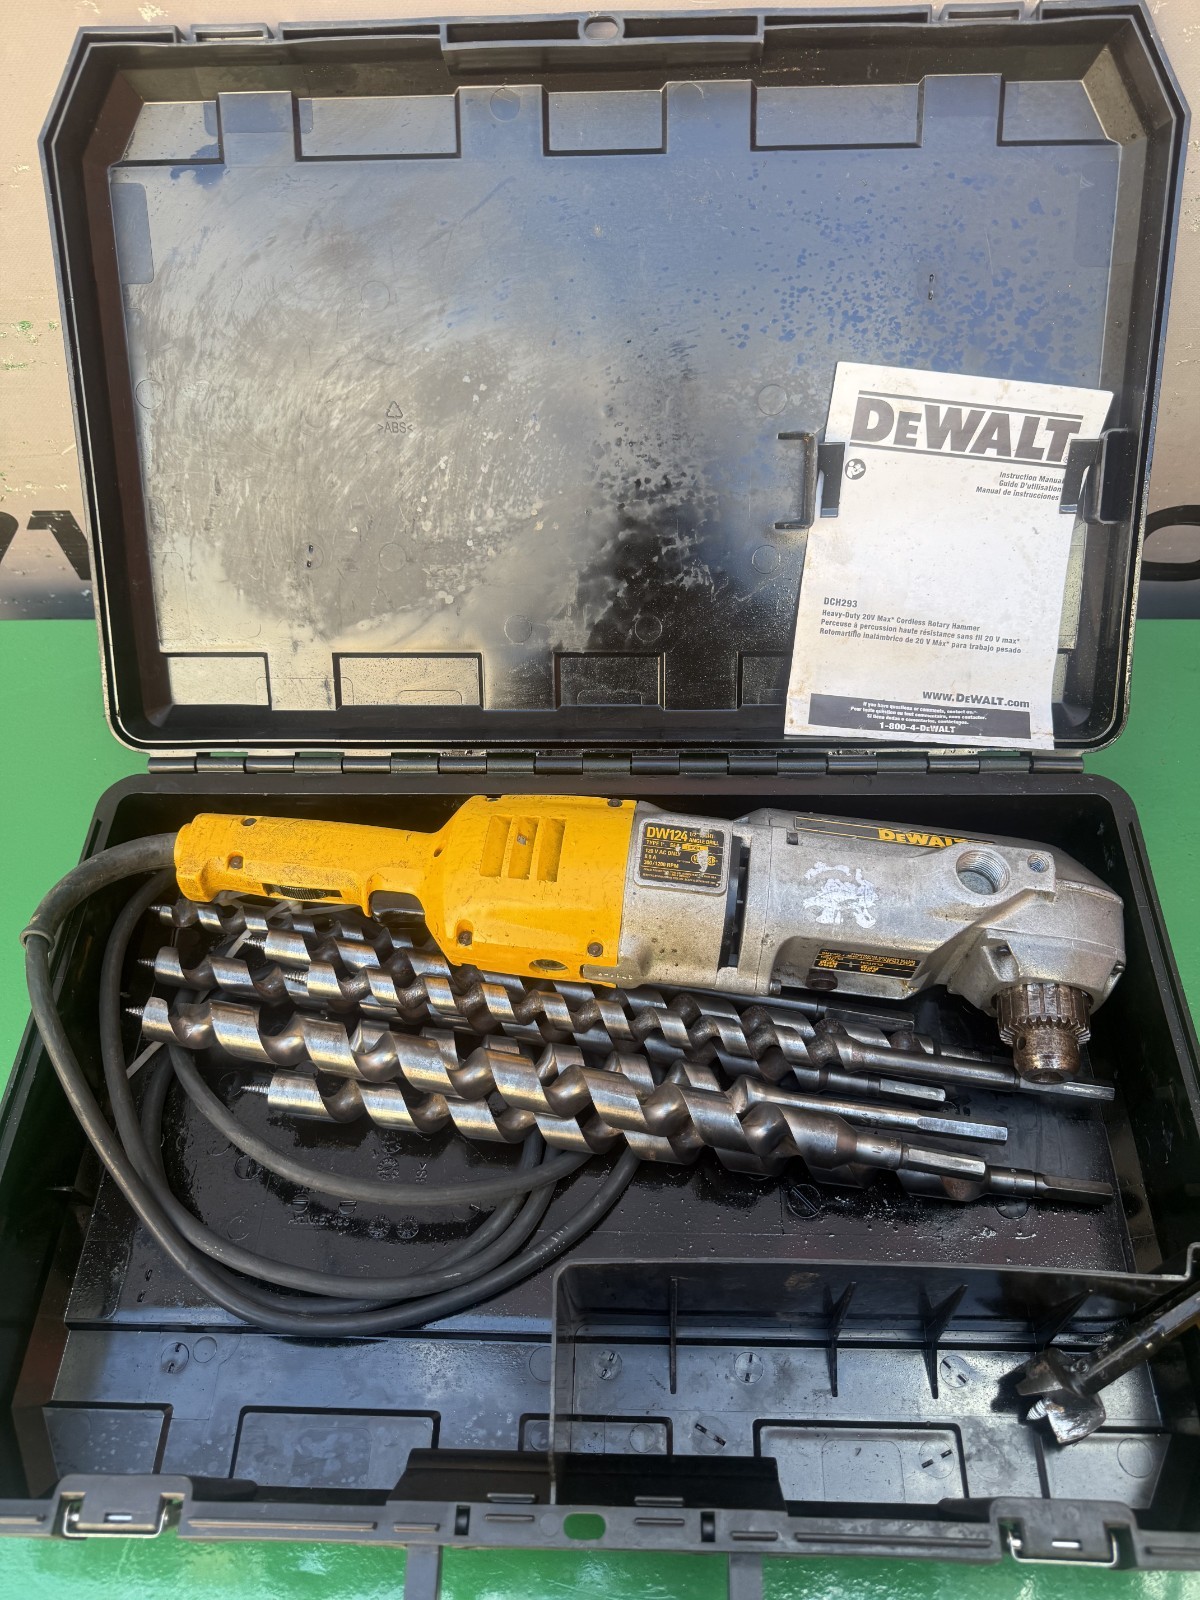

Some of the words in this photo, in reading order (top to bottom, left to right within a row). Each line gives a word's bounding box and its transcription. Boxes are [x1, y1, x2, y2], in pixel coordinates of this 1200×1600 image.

[850, 396, 1082, 463] DEWALT
[999, 471, 1037, 482] Instruction
[1039, 475, 1064, 484] Manua
[976, 486, 1001, 495] Manual
[1013, 490, 1059, 501] instrucciones
[999, 480, 1019, 488] Guide
[1020, 482, 1061, 493] D'utilisation
[823, 597, 858, 608] DCH293
[821, 618, 852, 628] Perceuse
[859, 623, 897, 633] percussion
[898, 626, 918, 635] haute
[919, 629, 955, 639] résistance
[822, 609, 861, 621] Heavy-Duty
[862, 613, 876, 621] 20V
[896, 616, 926, 626] Cordless
[927, 620, 950, 629] Rotary
[951, 622, 981, 632] Hammer
[862, 632, 903, 643] inalámbrico
[914, 637, 925, 645] 20
[969, 643, 994, 652] trabajo
[995, 646, 1022, 654] pesado
[922, 691, 1030, 708] www.DEWALT.com
[879, 721, 956, 733] 1-800-4-DEWALT
[646, 826, 688, 842] DW124
